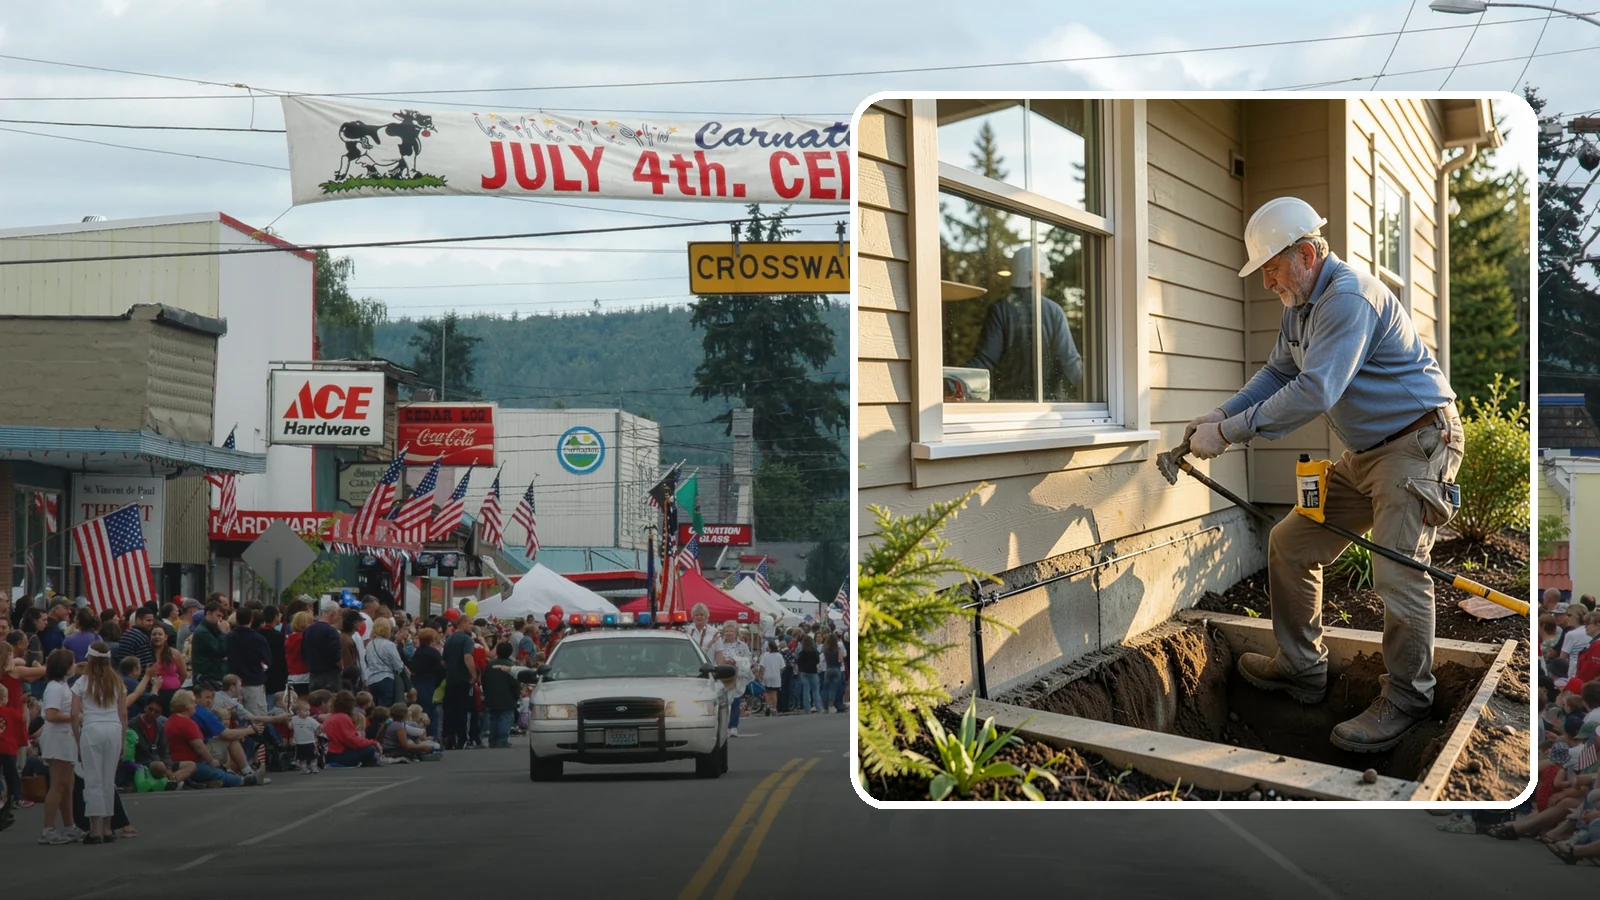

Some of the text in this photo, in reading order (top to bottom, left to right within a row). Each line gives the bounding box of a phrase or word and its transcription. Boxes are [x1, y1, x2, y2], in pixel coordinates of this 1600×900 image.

[481, 141, 604, 192] JULY
[632, 150, 746, 197] 4th.
[697, 254, 850, 280] CROSSWA
[282, 380, 373, 420] ACE
[406, 409, 485, 422] CEDAR LOG
[283, 421, 371, 436] Hardware
[416, 428, 477, 447] Coca-Cola
[83, 486, 155, 495] St. Vincent de Paul
[688, 526, 741, 535] CRNATION
[699, 535, 730, 543] GLASS
